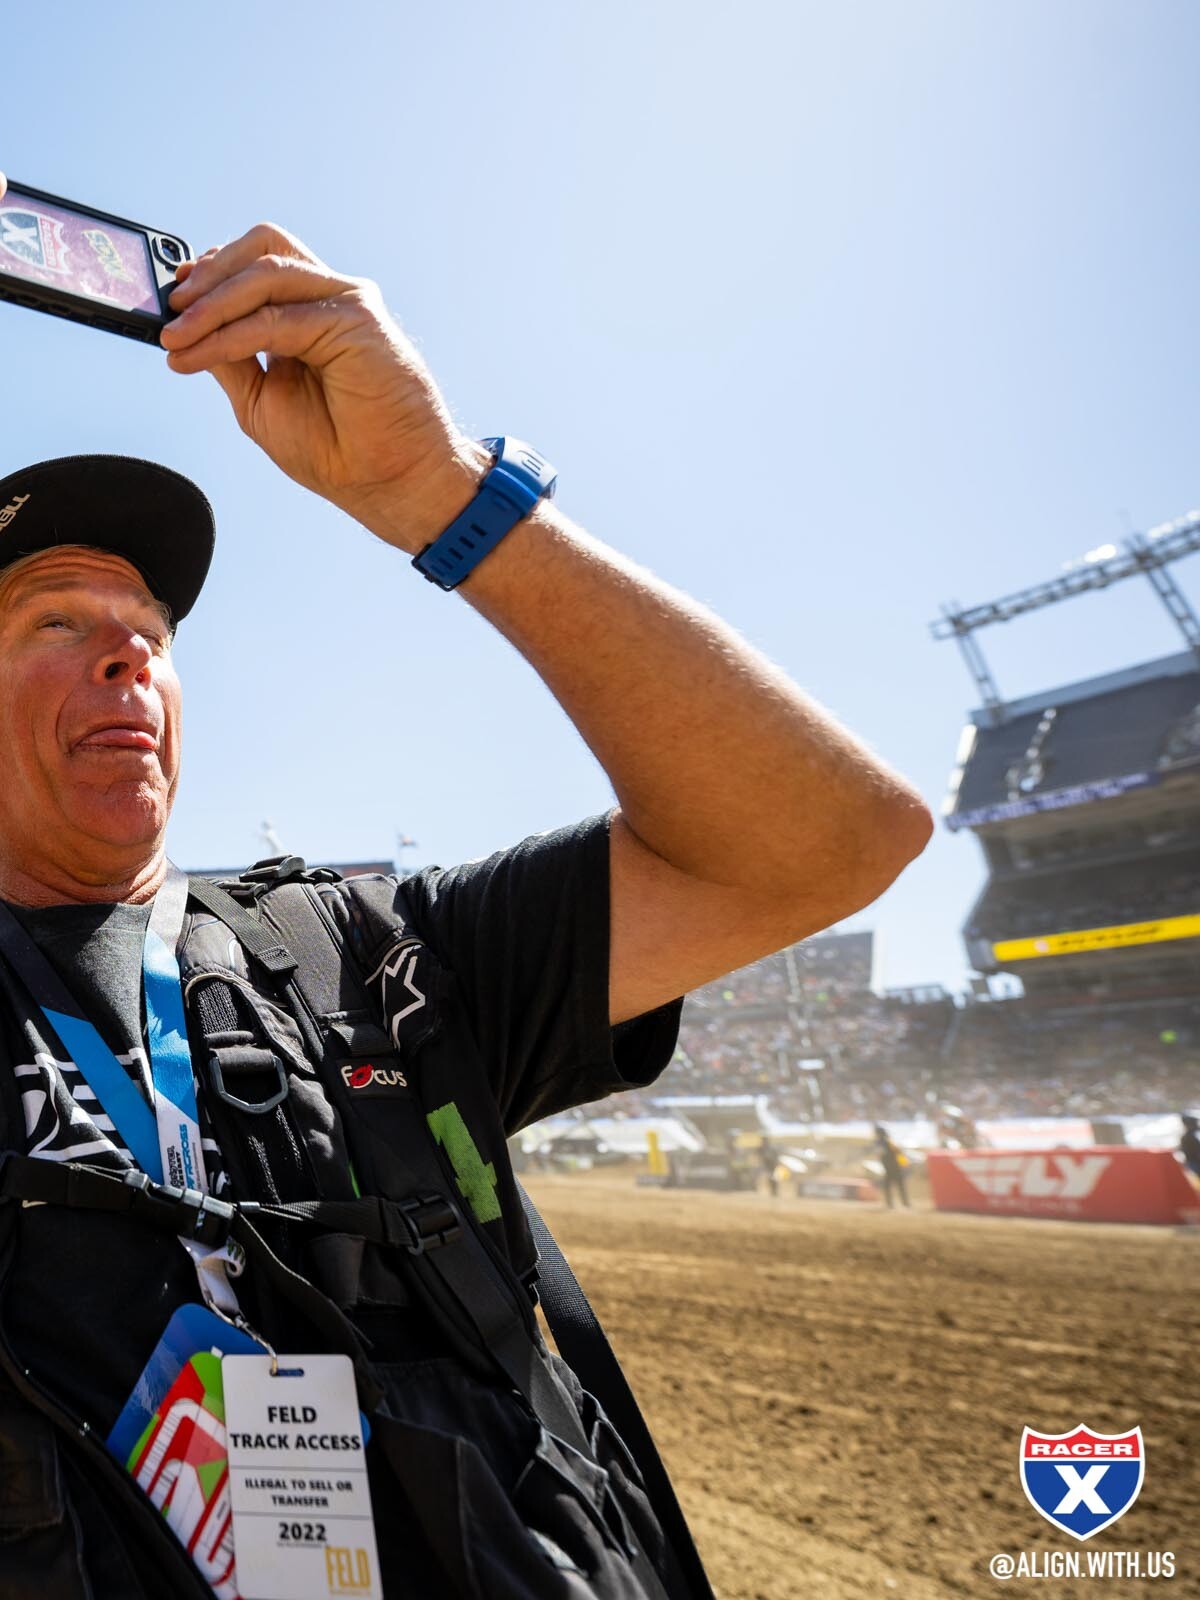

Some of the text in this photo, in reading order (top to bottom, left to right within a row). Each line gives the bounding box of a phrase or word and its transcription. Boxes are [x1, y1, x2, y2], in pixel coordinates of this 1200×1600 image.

[0, 215, 39, 251] X
[952, 1156, 1112, 1199] FLY
[267, 1406, 317, 1424] FELD
[230, 1433, 361, 1451] TRACK ACCESS
[245, 1478, 353, 1492] ILLEGAL TO SELL OR
[272, 1495, 329, 1508] TRANSFER
[279, 1522, 327, 1542] 2022
[324, 1545, 371, 1589] FELD
